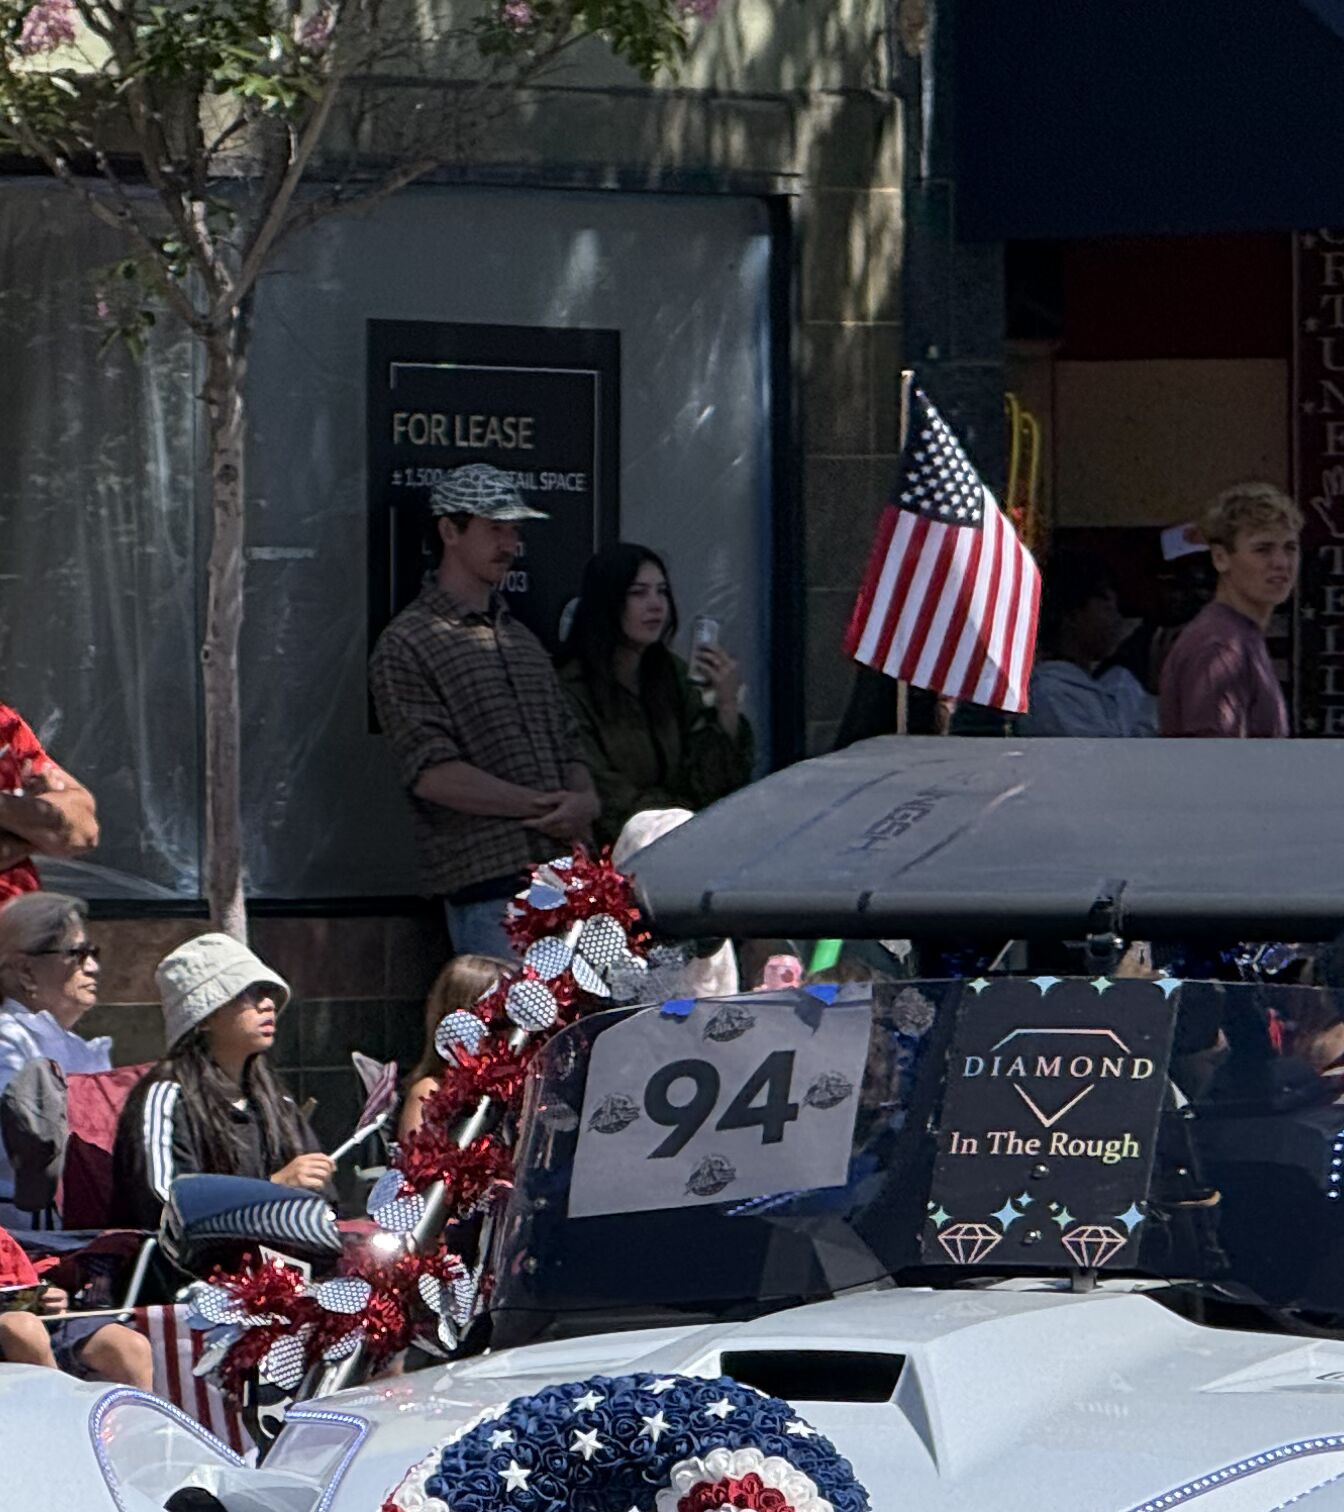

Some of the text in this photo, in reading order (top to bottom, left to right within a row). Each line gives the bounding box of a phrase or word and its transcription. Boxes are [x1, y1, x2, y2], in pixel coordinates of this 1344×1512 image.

[392, 412, 536, 450] FOR LEASE
[539, 471, 587, 493] SPACE
[962, 1052, 1155, 1082] DIAMOND
[644, 1049, 800, 1160] 94
[949, 1130, 1142, 1166] In The Rough
